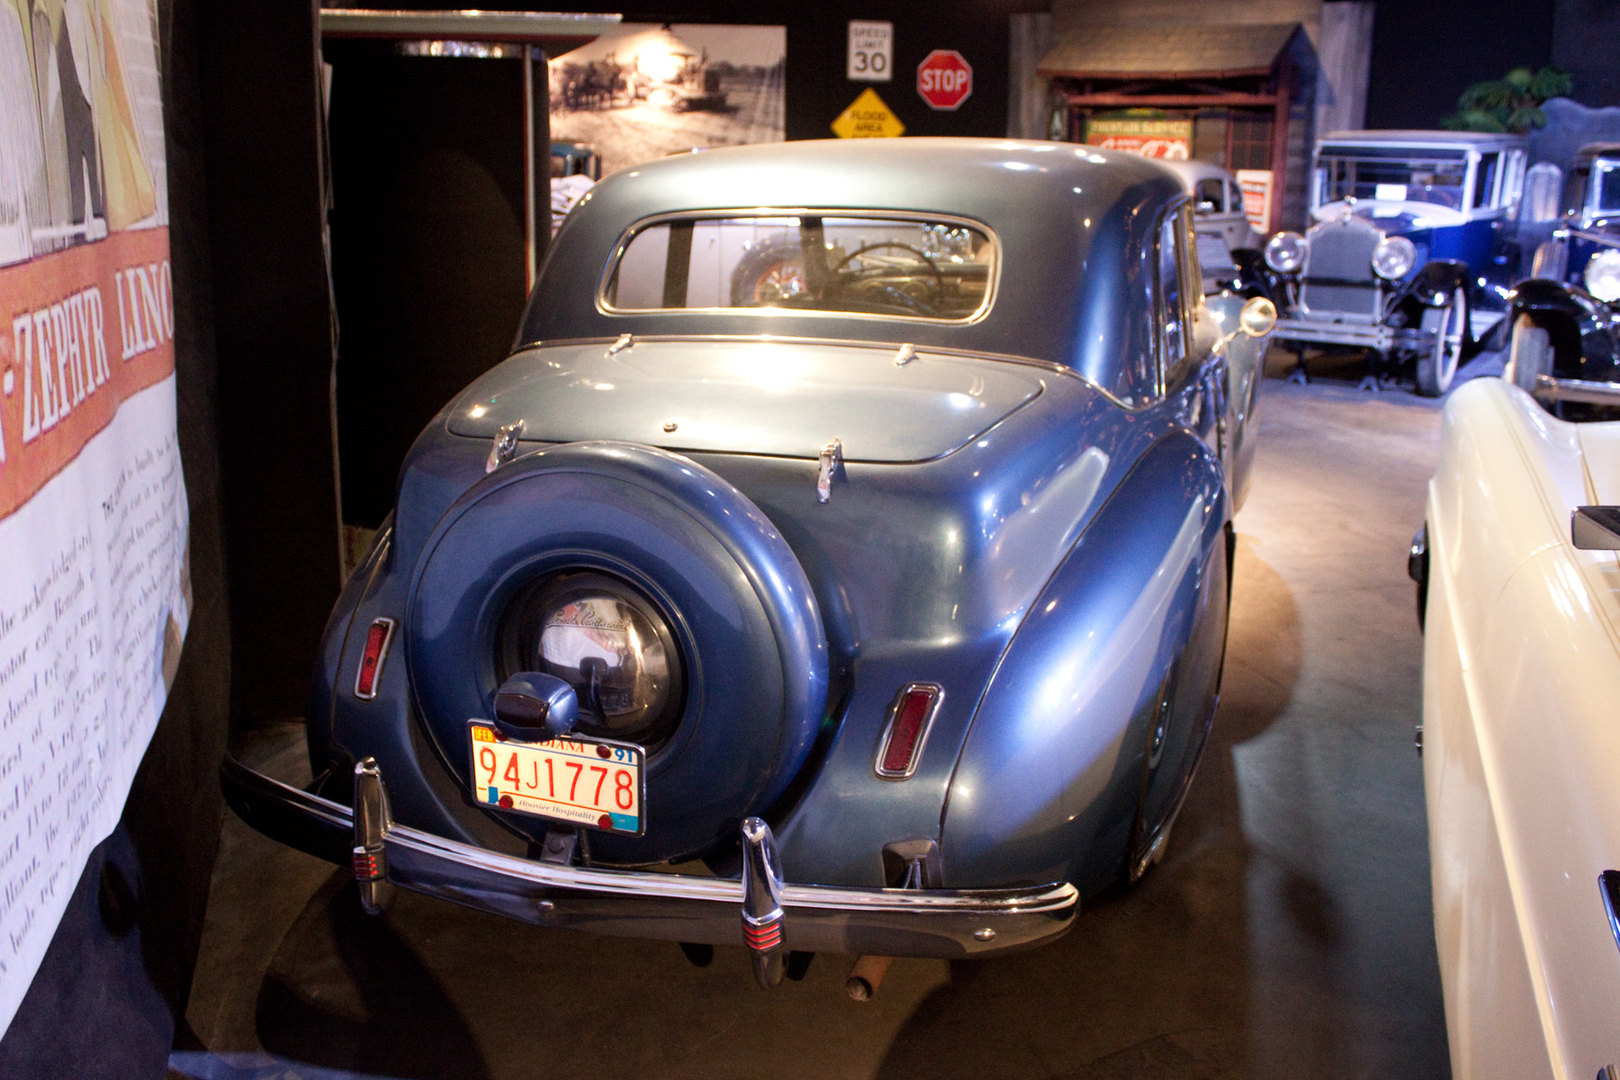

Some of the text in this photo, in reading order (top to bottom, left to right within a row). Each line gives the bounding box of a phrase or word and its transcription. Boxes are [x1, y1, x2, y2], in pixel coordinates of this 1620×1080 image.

[853, 28, 888, 38] SPEED
[855, 41, 884, 50] LIMIT
[854, 51, 886, 72] 30
[922, 69, 967, 91] STOP
[0, 286, 110, 462] -ZEPHYR
[478, 729, 493, 742] FEB
[534, 739, 585, 753] DIANA
[614, 748, 633, 763] 91
[479, 747, 634, 811] 94J1778
[518, 799, 596, 822] Hoosier Hospitality
